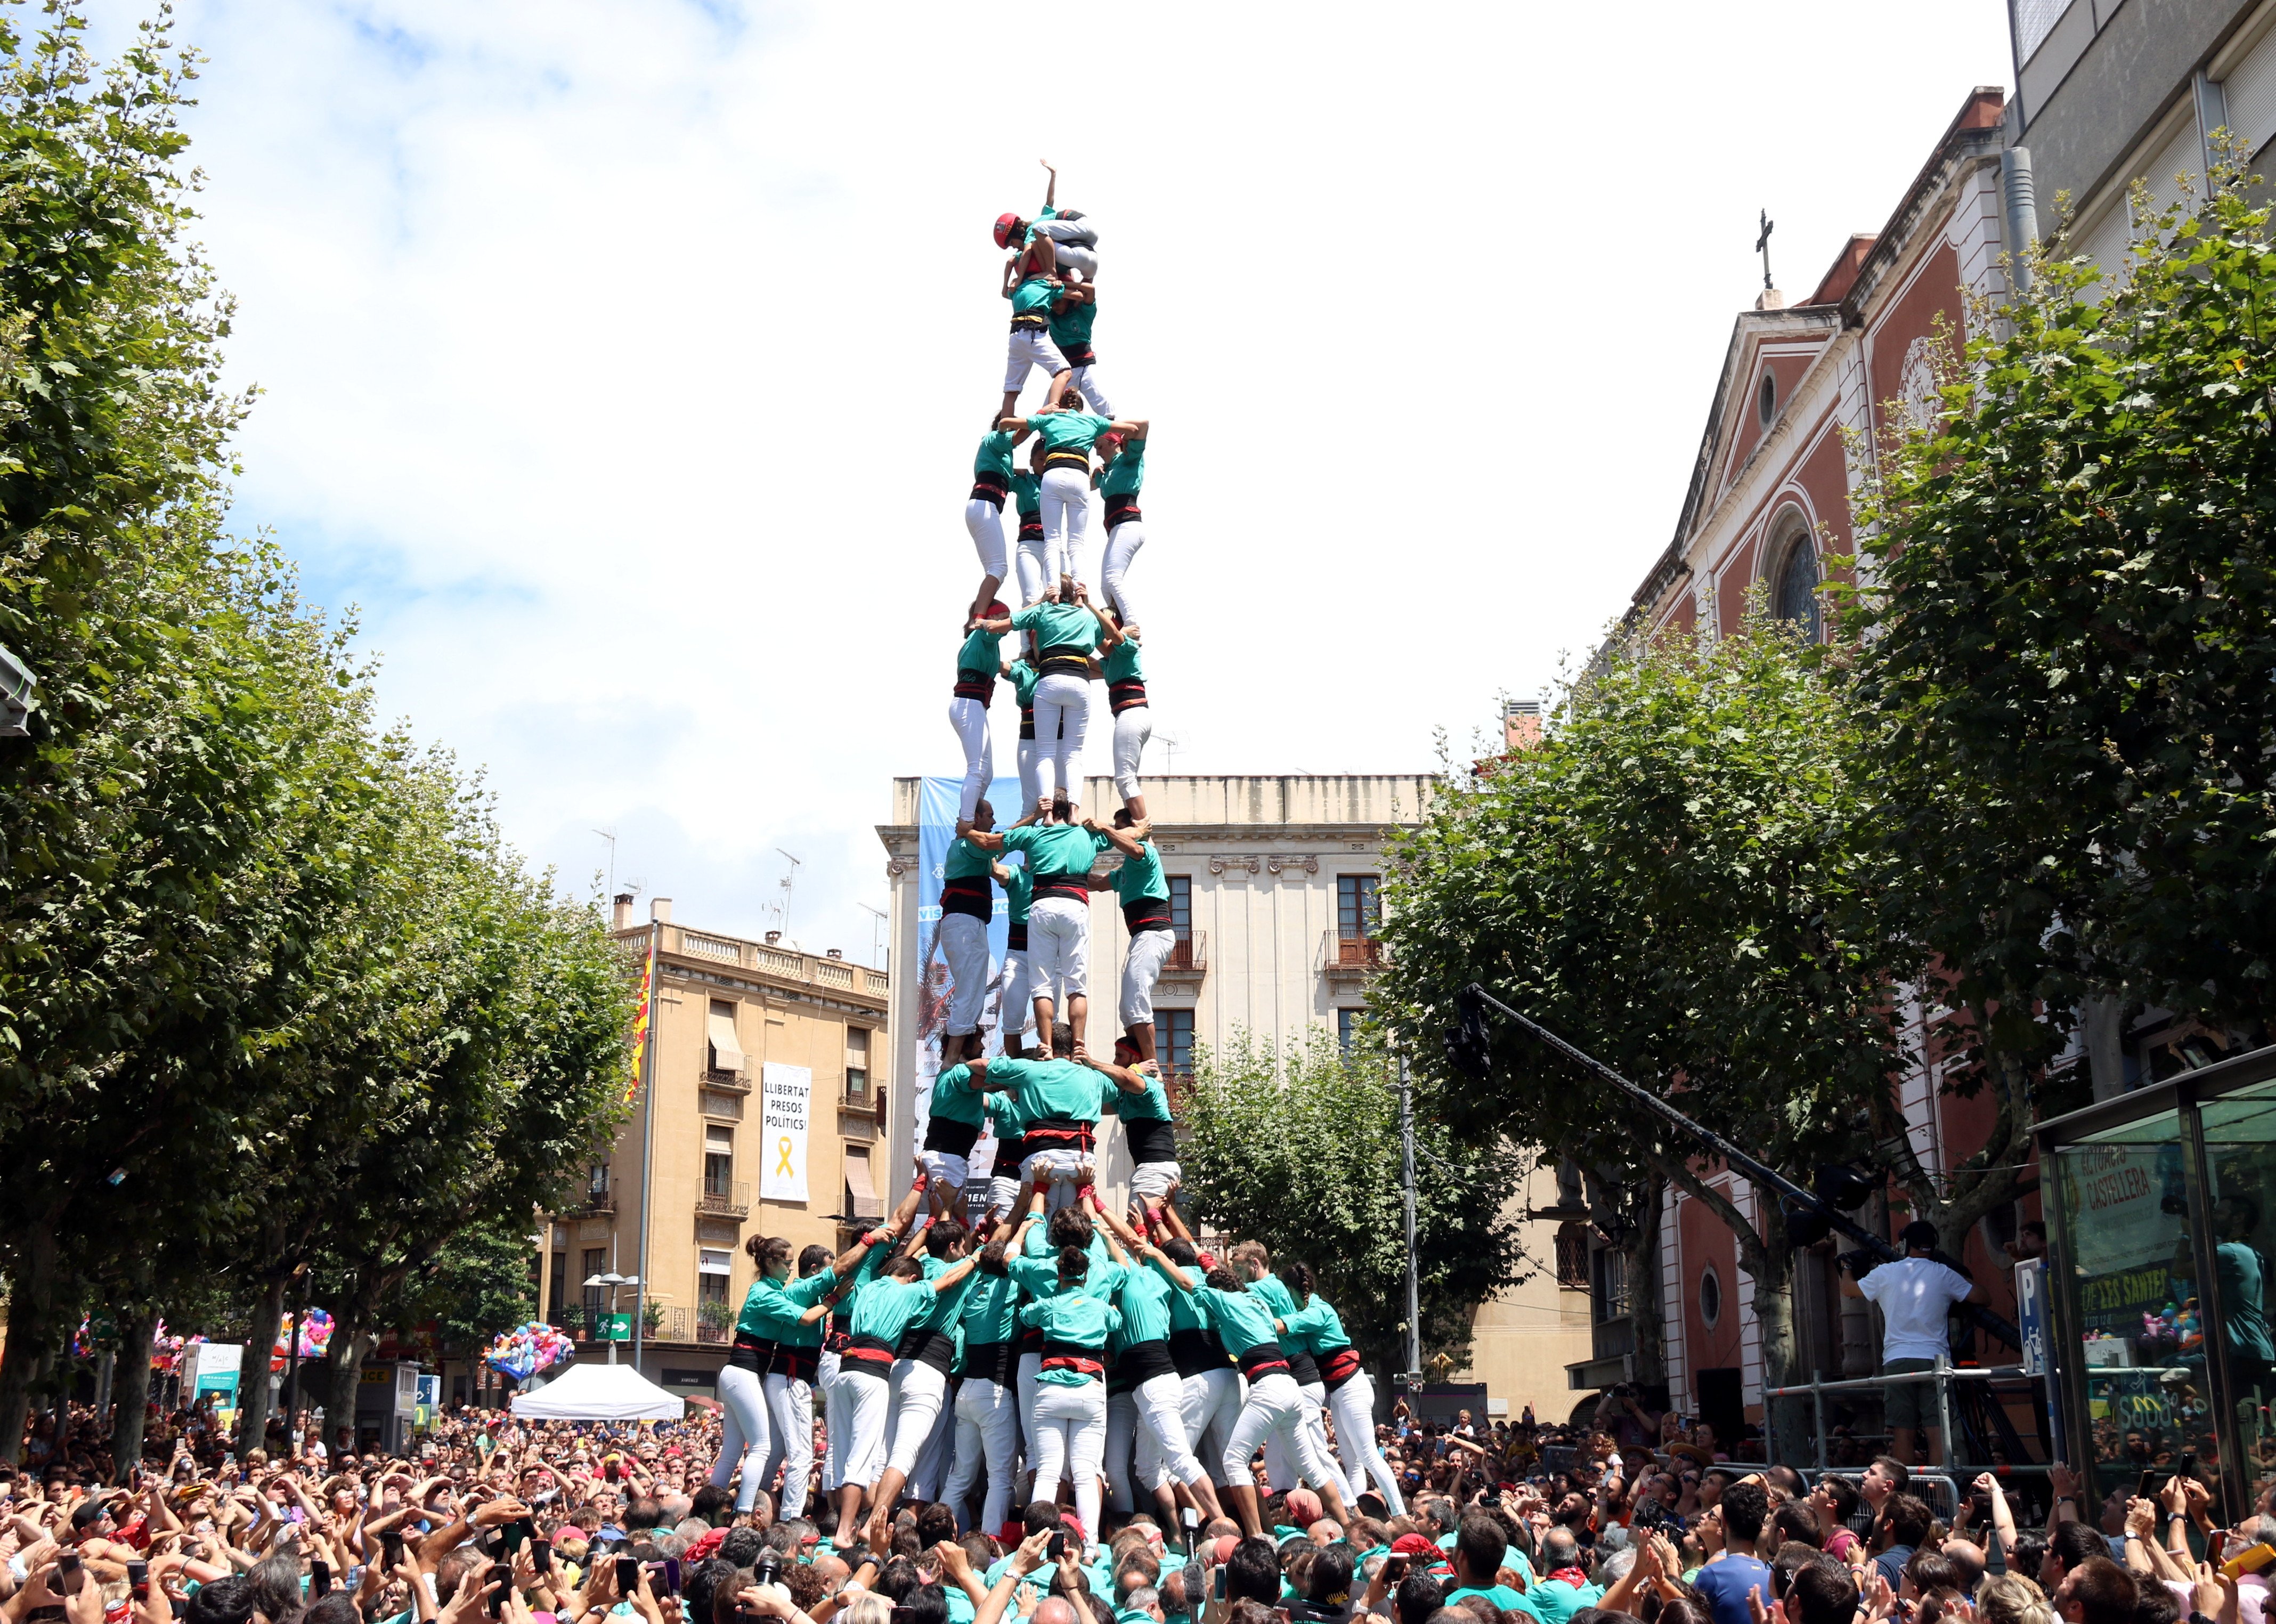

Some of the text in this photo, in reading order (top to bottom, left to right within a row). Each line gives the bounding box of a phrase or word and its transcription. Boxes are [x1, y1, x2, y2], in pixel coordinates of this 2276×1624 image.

[765, 1082, 809, 1098] LLIBERTAT
[771, 1099, 802, 1113] PRESOS
[766, 1115, 807, 1131] POLÍTICS!
[2086, 1165, 2151, 1211] CASTELLERA
[2021, 1268, 2034, 1317] P
[2123, 1268, 2168, 1305] SANTES
[361, 1370, 385, 1382] NCE
